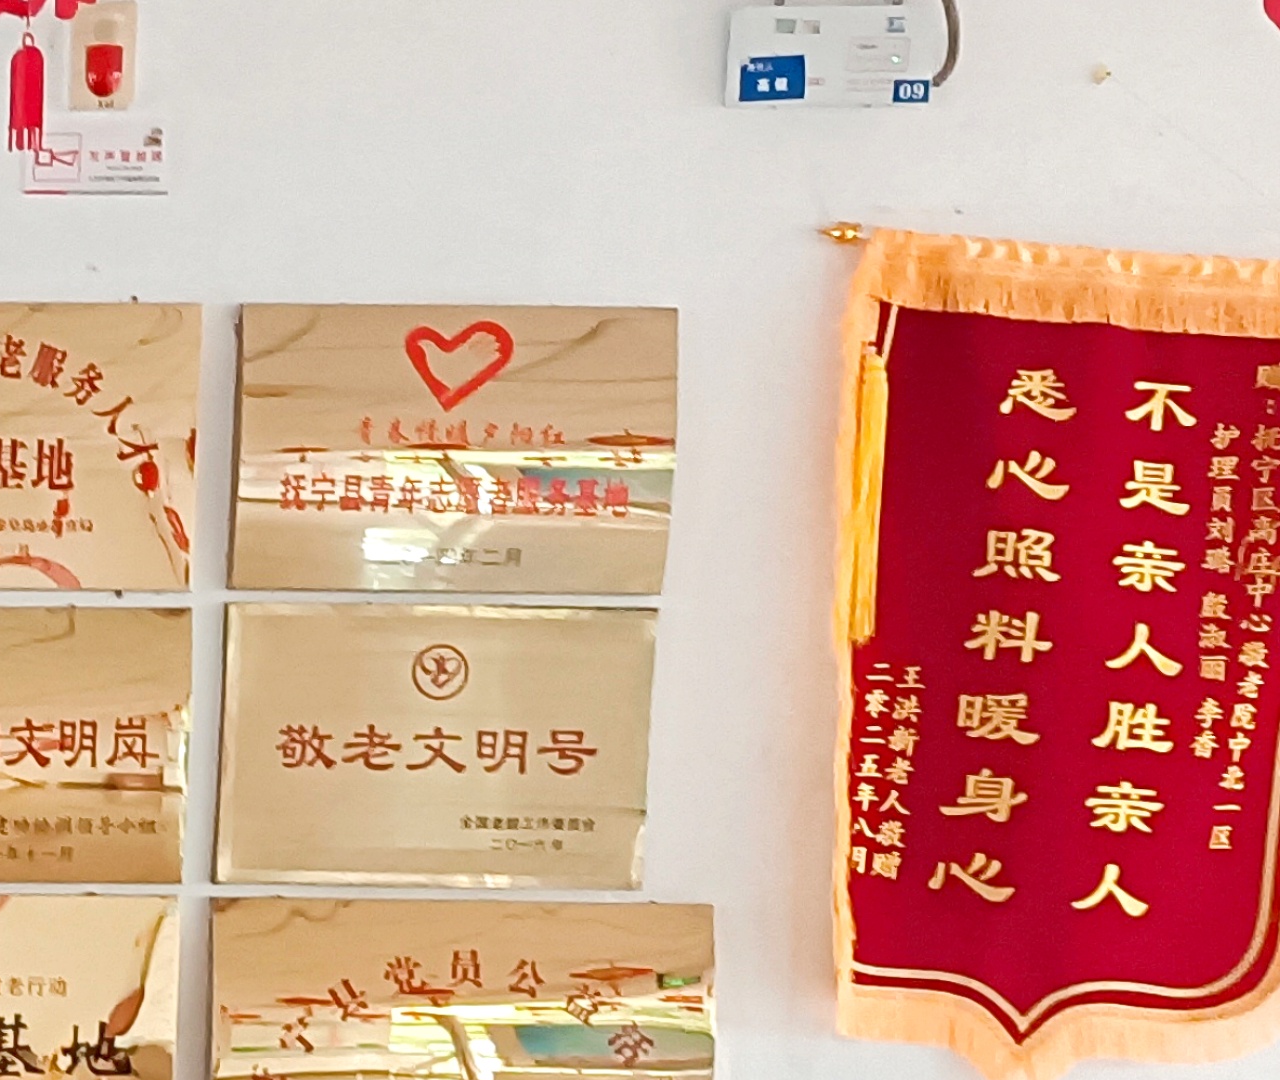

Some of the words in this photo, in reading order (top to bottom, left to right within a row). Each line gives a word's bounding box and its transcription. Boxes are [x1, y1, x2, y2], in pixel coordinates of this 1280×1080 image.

[898, 82, 925, 100] 09
[927, 368, 1078, 903] 悉心照料暖身心
[1070, 380, 1197, 917] 不是亲人胜亲人
[276, 723, 599, 776] 敬老文明号
[852, 662, 895, 875] 二零二五年八月
